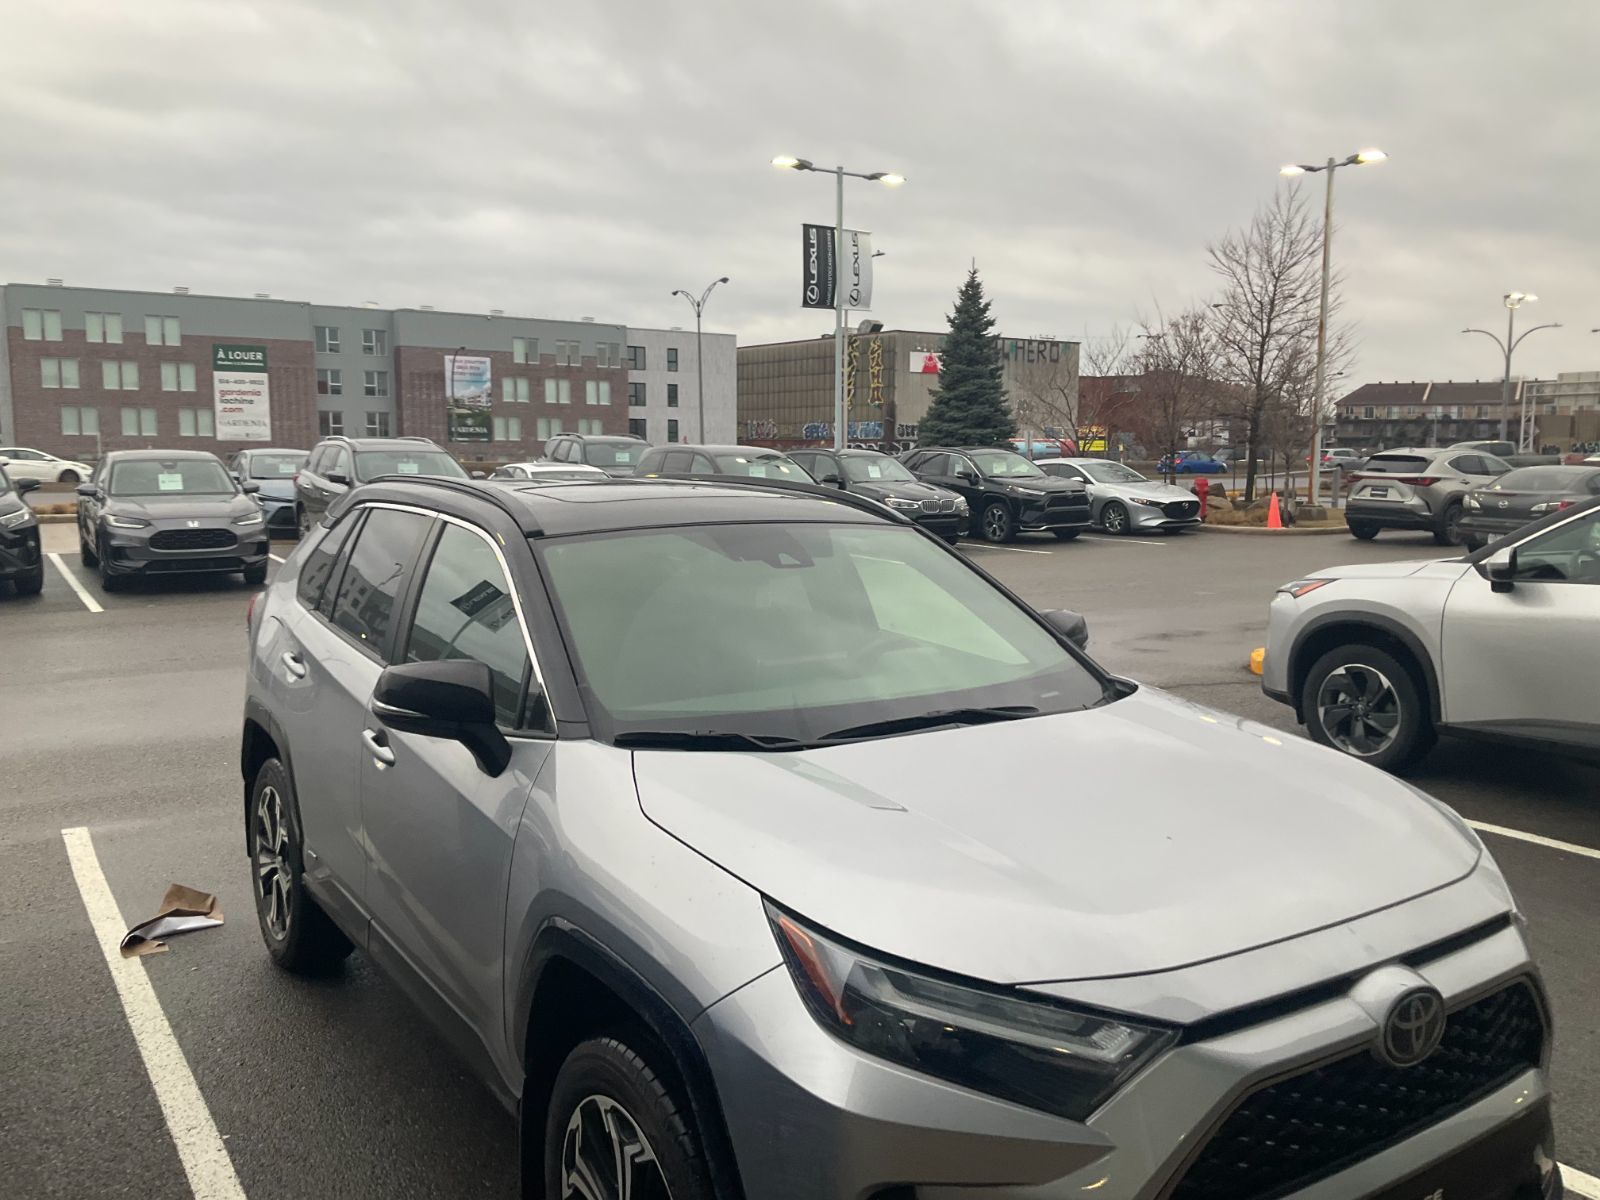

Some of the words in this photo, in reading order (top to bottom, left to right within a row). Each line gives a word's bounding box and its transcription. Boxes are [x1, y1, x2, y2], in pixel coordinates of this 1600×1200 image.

[809, 228, 818, 284] LEXUS
[852, 232, 860, 287] LEXUS
[217, 348, 226, 359] À
[228, 351, 264, 360] LOUER
[1015, 340, 1060, 364] HERO
[219, 387, 262, 398] gardenia
[219, 397, 255, 405] lachine
